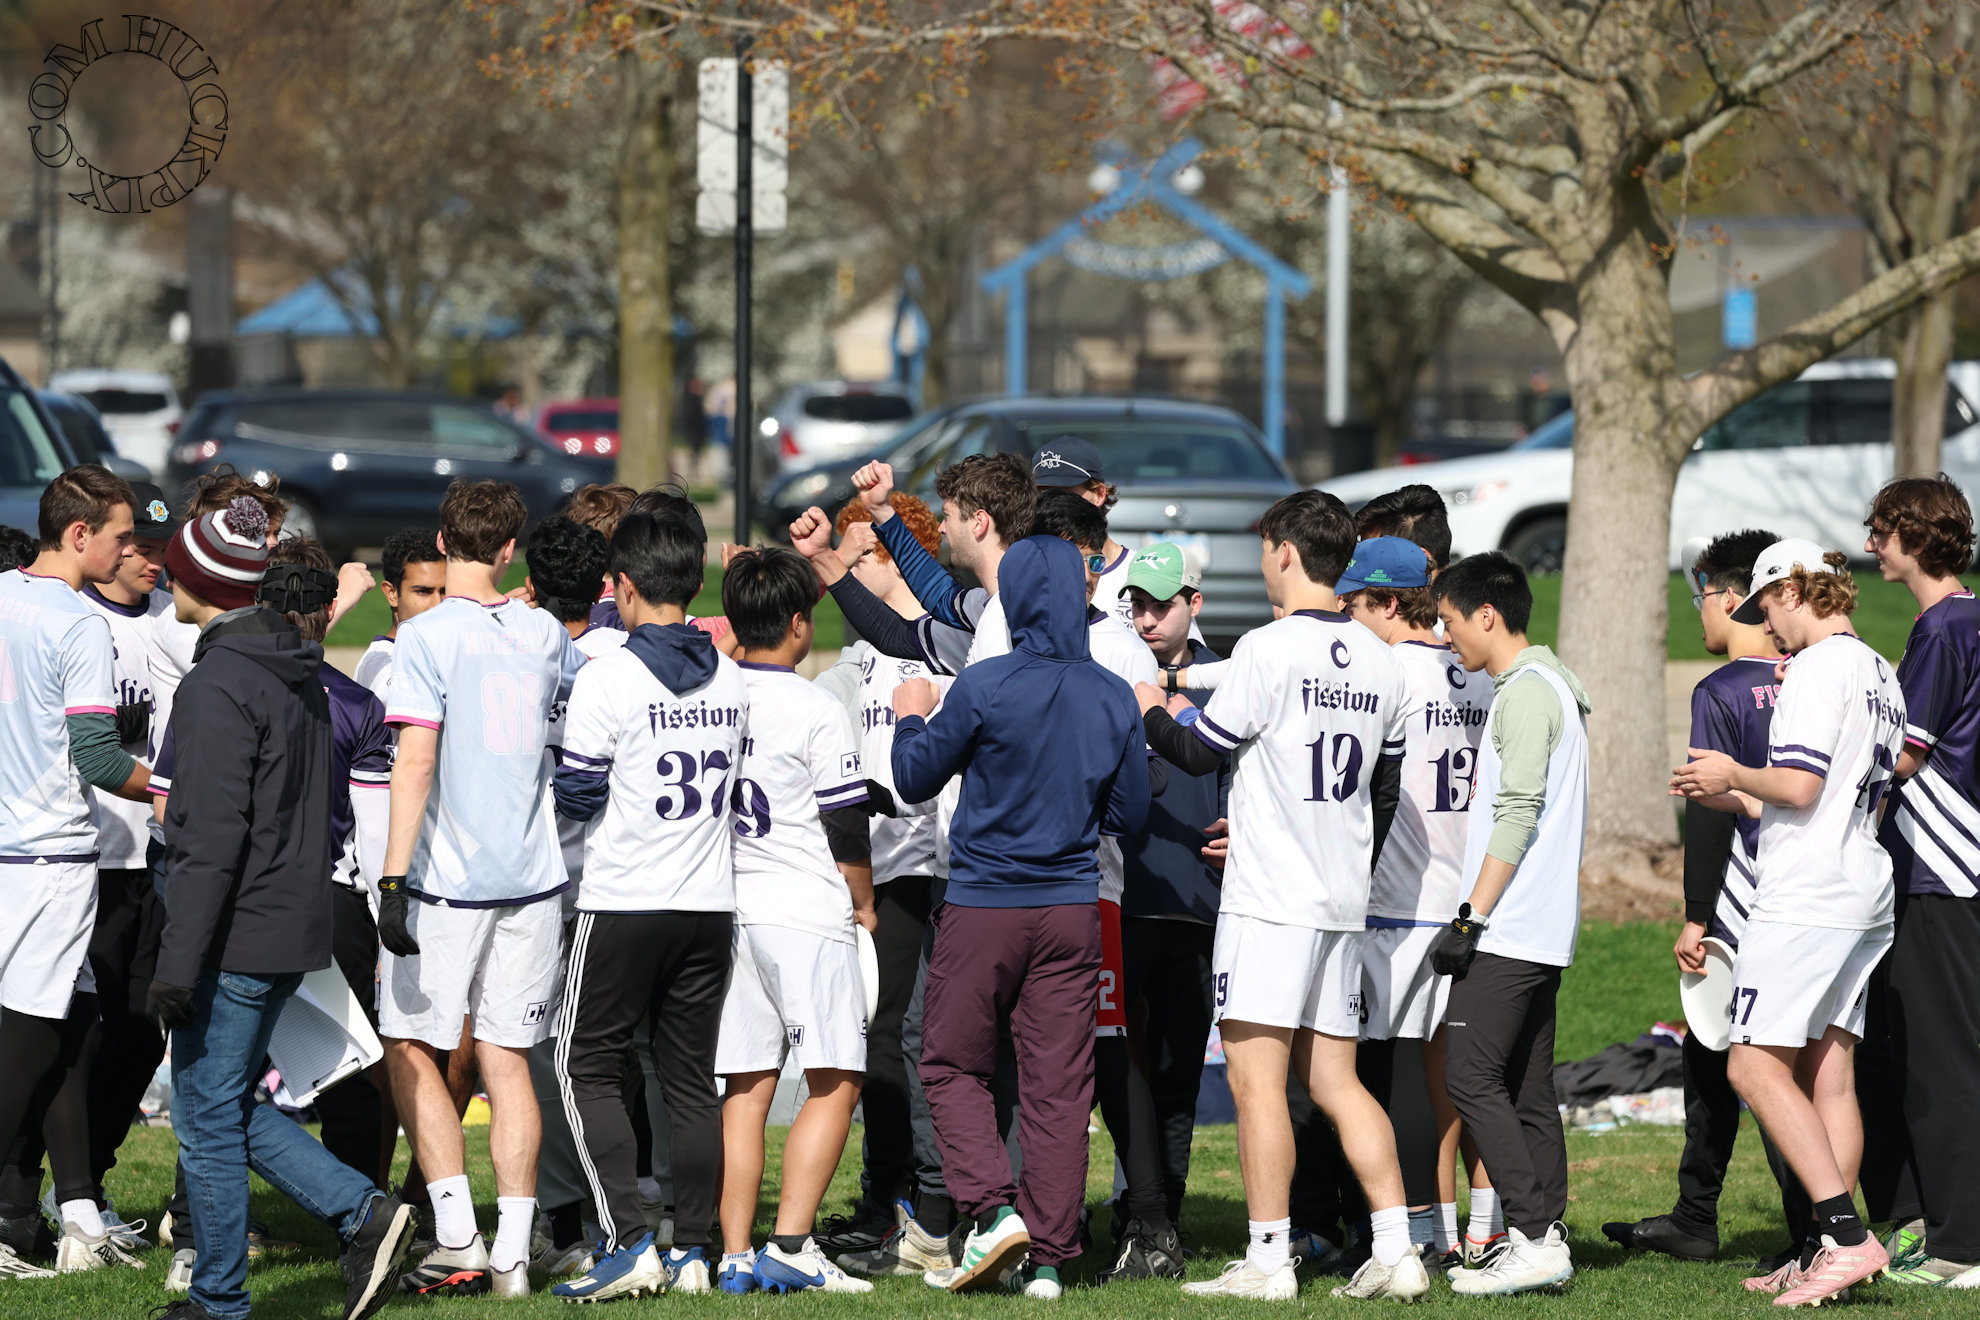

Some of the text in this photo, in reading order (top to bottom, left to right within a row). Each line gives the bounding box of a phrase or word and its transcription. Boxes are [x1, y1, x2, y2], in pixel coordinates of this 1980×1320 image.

[1301, 678, 1379, 716] fission
[648, 700, 739, 739] fission
[1425, 700, 1488, 736] fissio
[655, 747, 732, 820] 37
[1304, 731, 1363, 803] 19
[1427, 747, 1478, 812] 13
[1095, 970, 1117, 1010] 2
[1213, 972, 1228, 1008] 19
[1730, 986, 1758, 1025] 47
